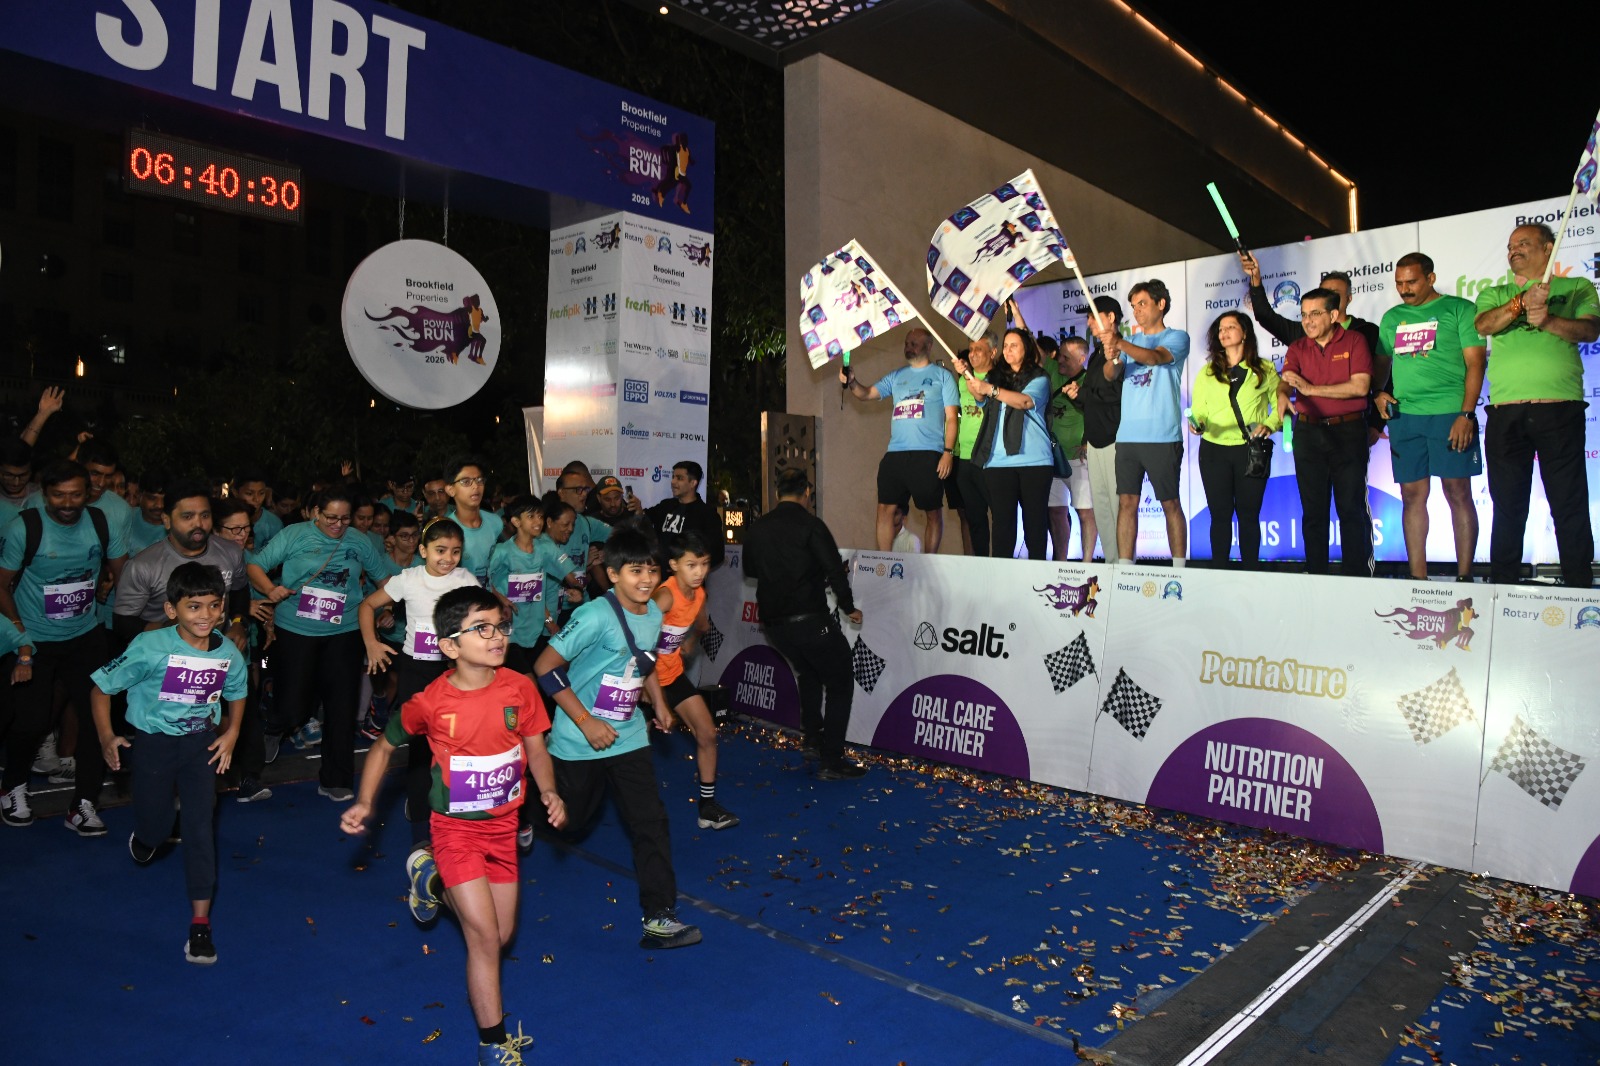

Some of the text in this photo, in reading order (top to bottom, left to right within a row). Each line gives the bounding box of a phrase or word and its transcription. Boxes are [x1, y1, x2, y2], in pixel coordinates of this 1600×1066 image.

[96, 0, 426, 140] START
[621, 101, 667, 125] Brookfield
[621, 116, 661, 137] Properties
[630, 146, 661, 165] POWAI
[629, 157, 661, 180] RUN
[130, 147, 300, 211] 06:40:30
[632, 193, 650, 205] 2026
[624, 232, 643, 244] Rotary
[571, 264, 597, 275] Brookfield
[653, 264, 685, 278] Brookfield
[405, 278, 454, 291] Brookfield
[653, 274, 681, 287] Properties
[406, 291, 449, 303] Properties
[1205, 297, 1241, 310] Rotary
[625, 296, 666, 316] freshpik
[423, 319, 454, 330] POWAI
[423, 328, 455, 341] RUN
[1402, 331, 1428, 341] 44421
[425, 355, 445, 364] 2026
[625, 382, 647, 392] GIOS
[625, 392, 647, 402] EPPO
[654, 389, 677, 399] VOLTAS
[621, 426, 649, 436] Bonanza
[680, 432, 705, 442] PROWL
[858, 564, 875, 573] Rotary
[514, 582, 537, 591] 41499
[1117, 583, 1141, 593] Rotary
[1411, 587, 1453, 597] Brookfield
[55, 592, 87, 605] 40063
[1060, 594, 1079, 604] RUN
[1411, 596, 1447, 605] Properties
[1507, 592, 1528, 600] Rotary
[308, 597, 337, 611] 44060
[1417, 614, 1445, 624] POWAI
[1503, 607, 1540, 621] Rotary
[1416, 621, 1445, 633] RUN
[941, 623, 1010, 659] salt.
[177, 670, 217, 684] 41653
[744, 661, 775, 688] TRAVEL
[1200, 650, 1347, 700] PentaSure
[736, 681, 777, 711] PARTNER
[912, 693, 996, 731] ORAL CARE
[441, 713, 456, 738] 7
[914, 720, 985, 757] PARTNER
[1204, 740, 1324, 789] NUTRITION
[465, 766, 513, 788] 41660
[1207, 773, 1312, 822] PARTNER
